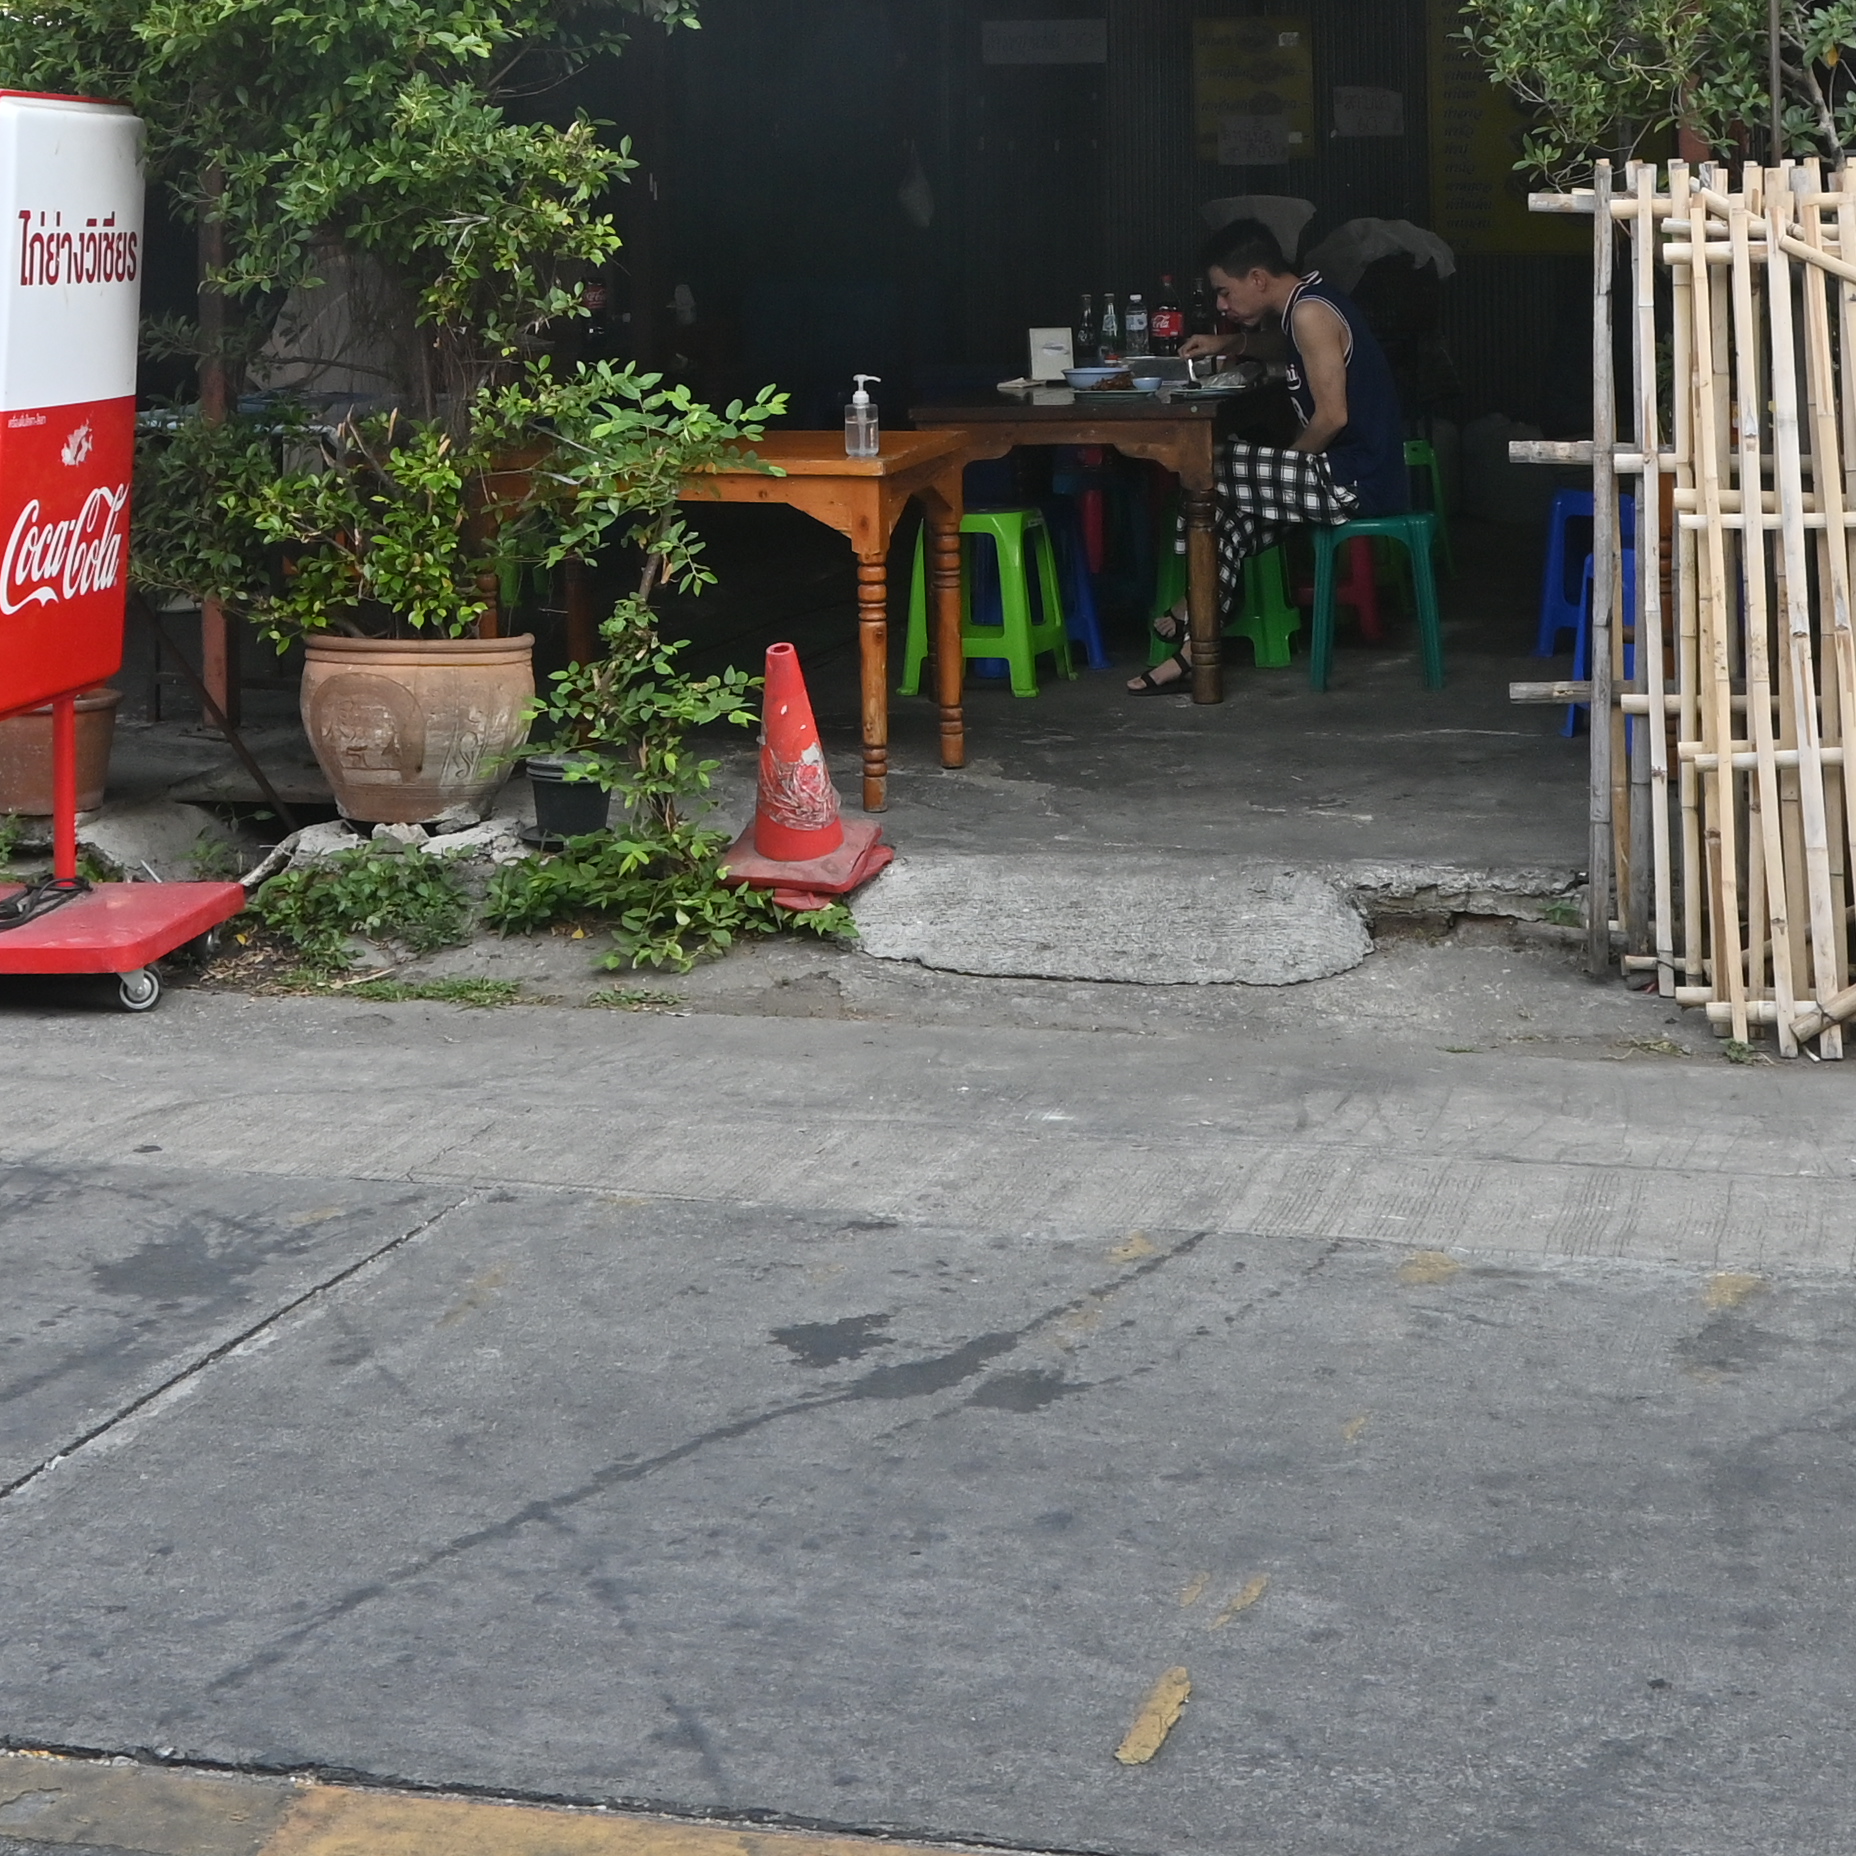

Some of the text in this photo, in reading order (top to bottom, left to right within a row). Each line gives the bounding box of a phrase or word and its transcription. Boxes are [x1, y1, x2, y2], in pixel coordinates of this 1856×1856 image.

[18, 209, 138, 286] ไก่ย่างวิเชียร
